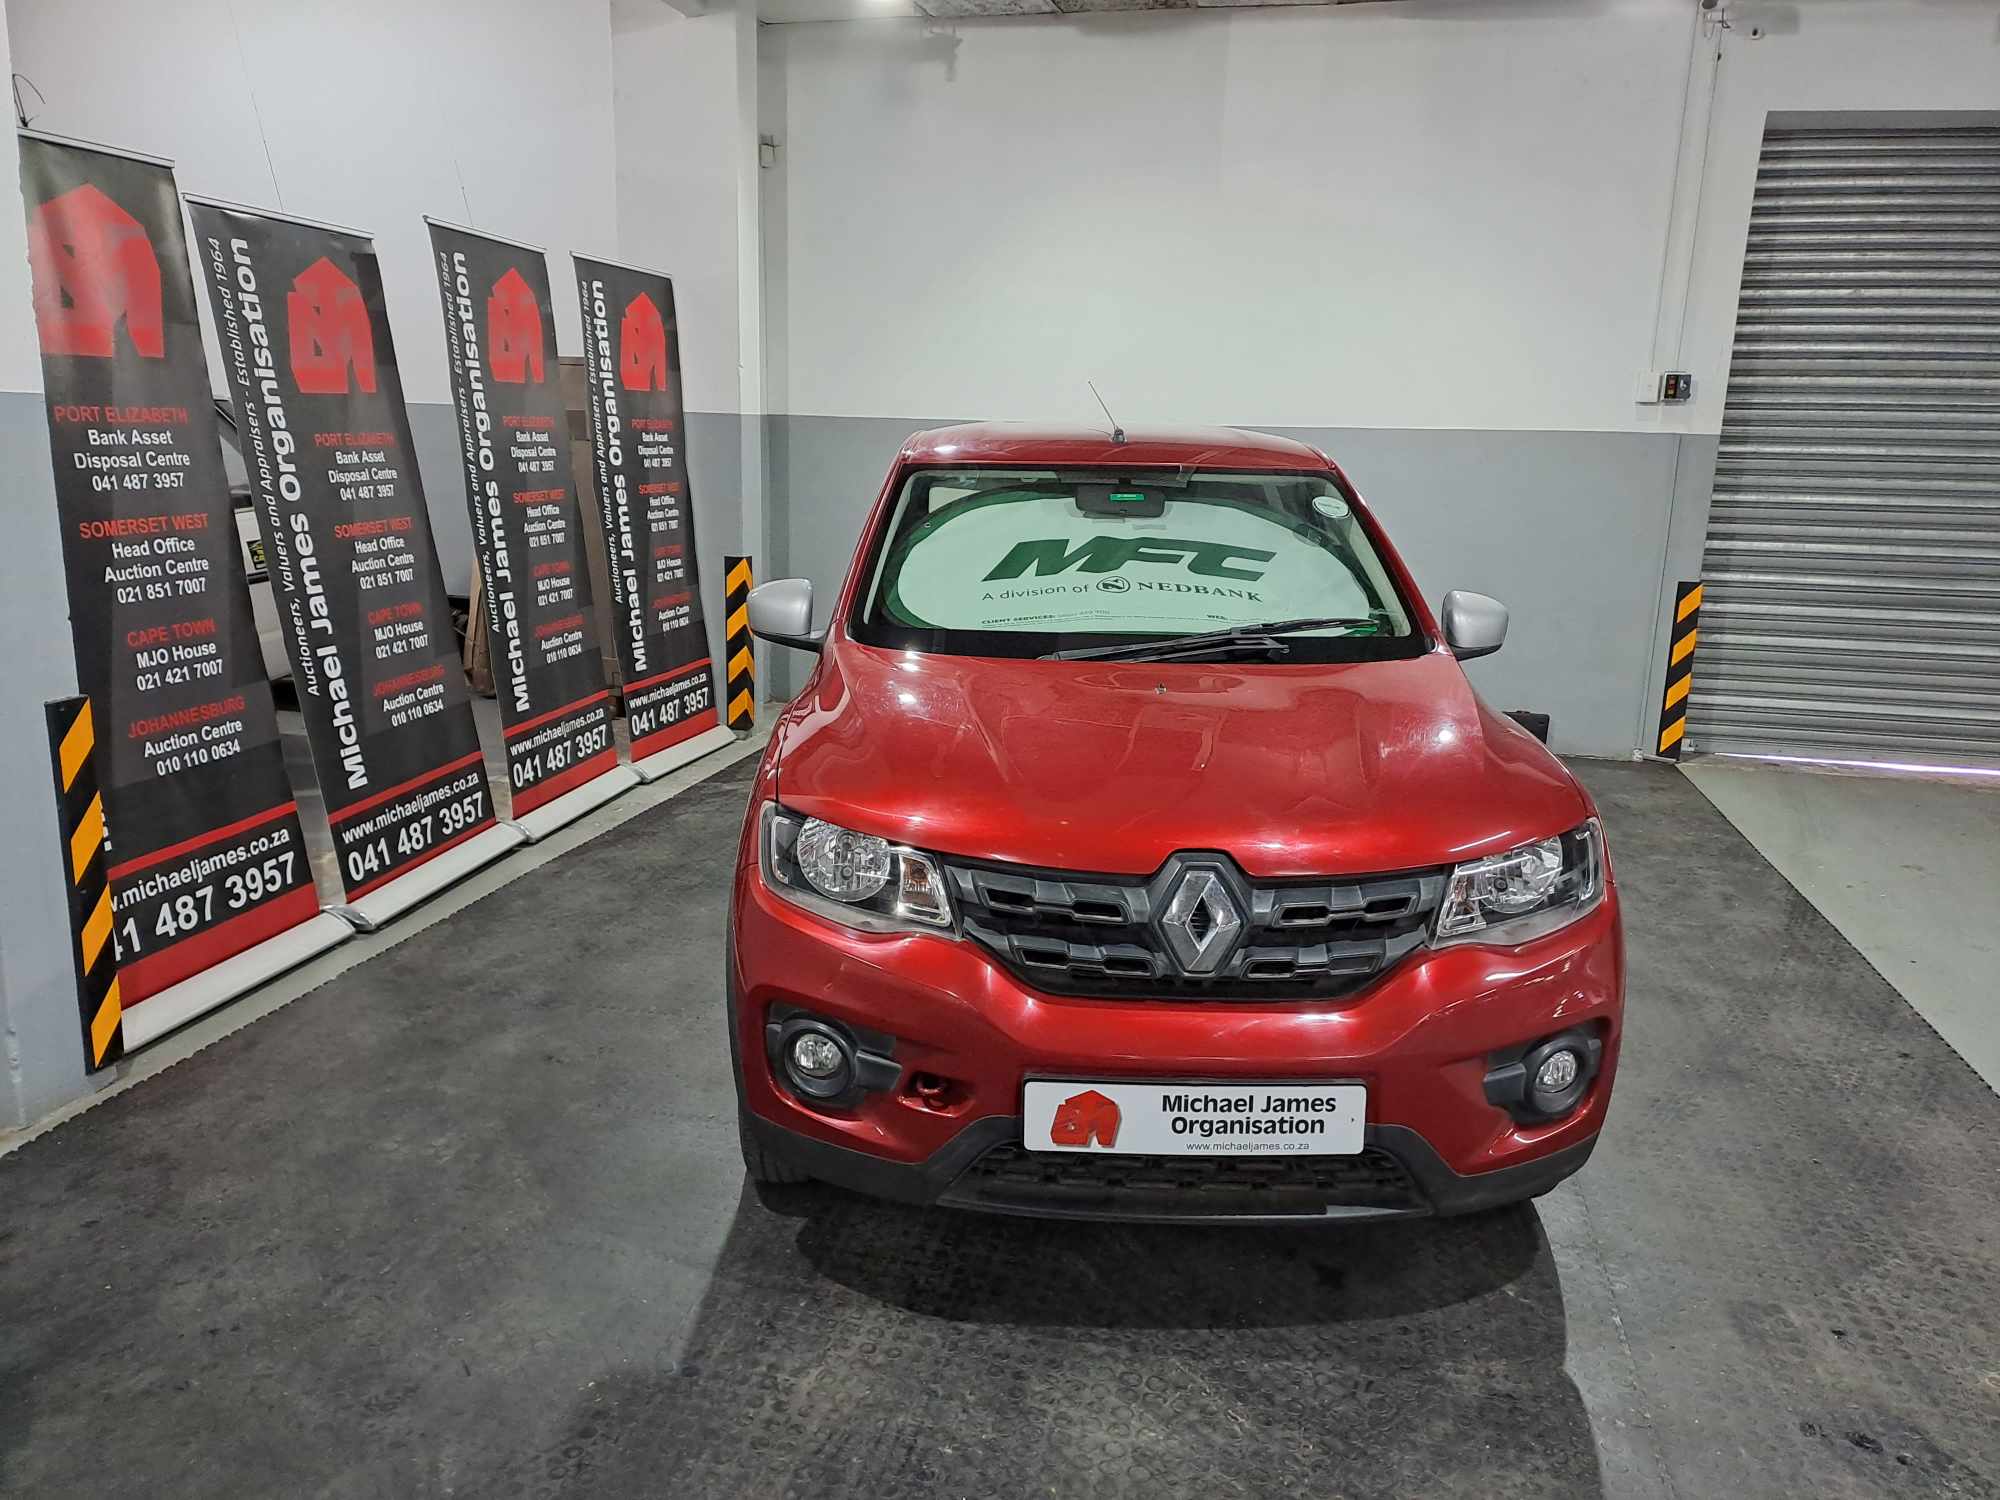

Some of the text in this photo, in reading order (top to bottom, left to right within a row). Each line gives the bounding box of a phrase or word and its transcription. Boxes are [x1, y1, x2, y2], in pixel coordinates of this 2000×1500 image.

[208, 237, 228, 281] 1964
[219, 286, 250, 386] Established
[446, 291, 462, 375] Established
[230, 238, 301, 501] Organisation
[54, 406, 188, 424] PORT ELIZABETH
[459, 388, 475, 462] Appraisers
[88, 429, 173, 446] Bank Asset
[245, 401, 272, 491] Appraisers
[73, 451, 190, 471] Disposal Centre
[335, 450, 385, 464] Bank Asset
[597, 460, 607, 483] and
[92, 472, 184, 491] 041 487 3957
[328, 467, 398, 484] Disposal Centre
[453, 252, 530, 713] Michael James Organisation
[467, 464, 480, 491] and
[592, 280, 647, 672] Michael James Organisation
[340, 487, 356, 501] 041
[358, 486, 374, 499] 487
[80, 513, 208, 538] SOMERSET WEST
[261, 494, 281, 527] and
[474, 495, 487, 545] Valuers
[112, 537, 195, 559] Head Office
[354, 536, 405, 554] Head Office
[981, 536, 1277, 582] MFC
[104, 557, 209, 583] Auction Centre
[276, 531, 295, 592] Valuers
[290, 512, 333, 634] James
[352, 553, 414, 573] Auction Centre
[117, 577, 206, 604] 021 851 7007
[360, 568, 414, 590] 021 851 7007
[483, 551, 500, 633] Auctioneers,
[1000, 586, 1066, 600] division
[1072, 584, 1089, 593] of
[1138, 582, 1263, 603] NEDBANK
[127, 618, 216, 647] CAPE TOWN
[374, 620, 424, 642] MJO House
[136, 642, 217, 670] MJO House
[290, 598, 320, 696] Auctioneers,
[375, 634, 429, 660] 021 421 7007
[136, 659, 223, 691] 021 421 7007
[383, 683, 444, 713] Auction Centre
[391, 699, 444, 727] 010 110 0634
[631, 687, 709, 736] 041 487 3957
[129, 695, 246, 738] JOHANNESBURG
[316, 645, 369, 791] Michael
[510, 707, 604, 757] www.michaeljames.co.za
[144, 719, 243, 758] Auction Centre
[156, 739, 241, 777] 010 110 0634
[513, 724, 607, 789] 041 487 3957
[342, 771, 479, 844] www.michaeljames.co.za
[348, 790, 483, 881] 041 487 3957
[155, 885, 213, 937] 487
[225, 851, 295, 909] 3957
[1162, 1094, 1337, 1113] Michael James
[1171, 1116, 1325, 1137] Organisation
[1186, 1141, 1310, 1152] www.michaeljames.co.za
